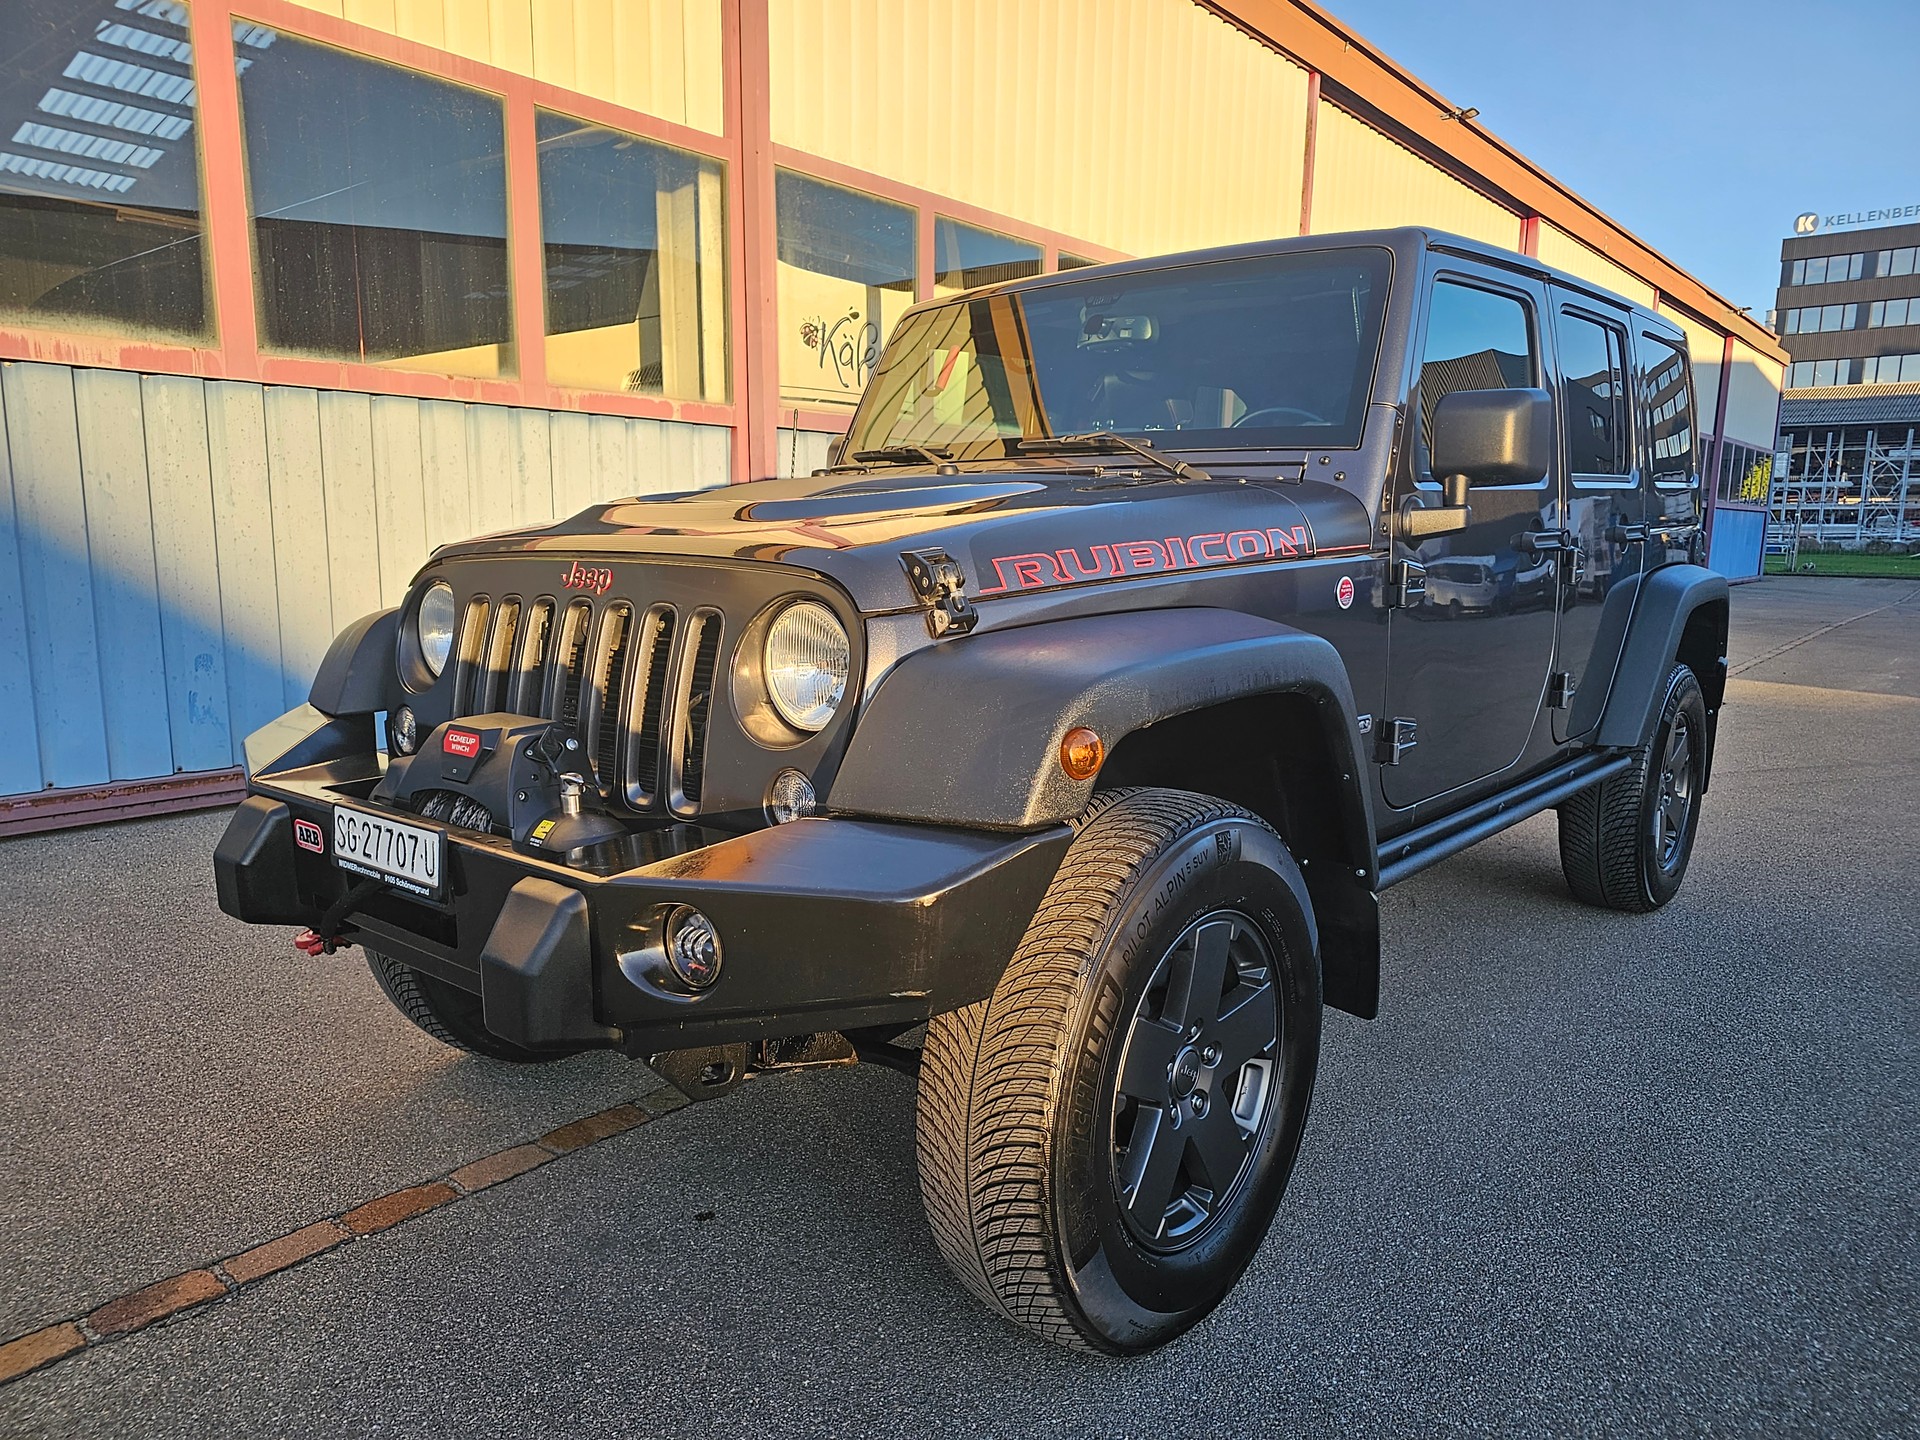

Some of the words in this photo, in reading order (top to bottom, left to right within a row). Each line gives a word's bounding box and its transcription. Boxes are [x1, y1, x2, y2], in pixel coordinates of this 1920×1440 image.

[1797, 215, 1816, 233] K
[979, 525, 1315, 594] RUBICON
[560, 560, 613, 596] Jeep
[449, 734, 475, 745] COMEUP
[451, 743, 470, 752] WINCH
[298, 826, 320, 847] ARB
[384, 873, 396, 885] 9105
[1122, 910, 1153, 968] PILOT
[1154, 868, 1187, 916] ALPIN
[1185, 862, 1192, 875] 5
[1193, 848, 1209, 869] SUV
